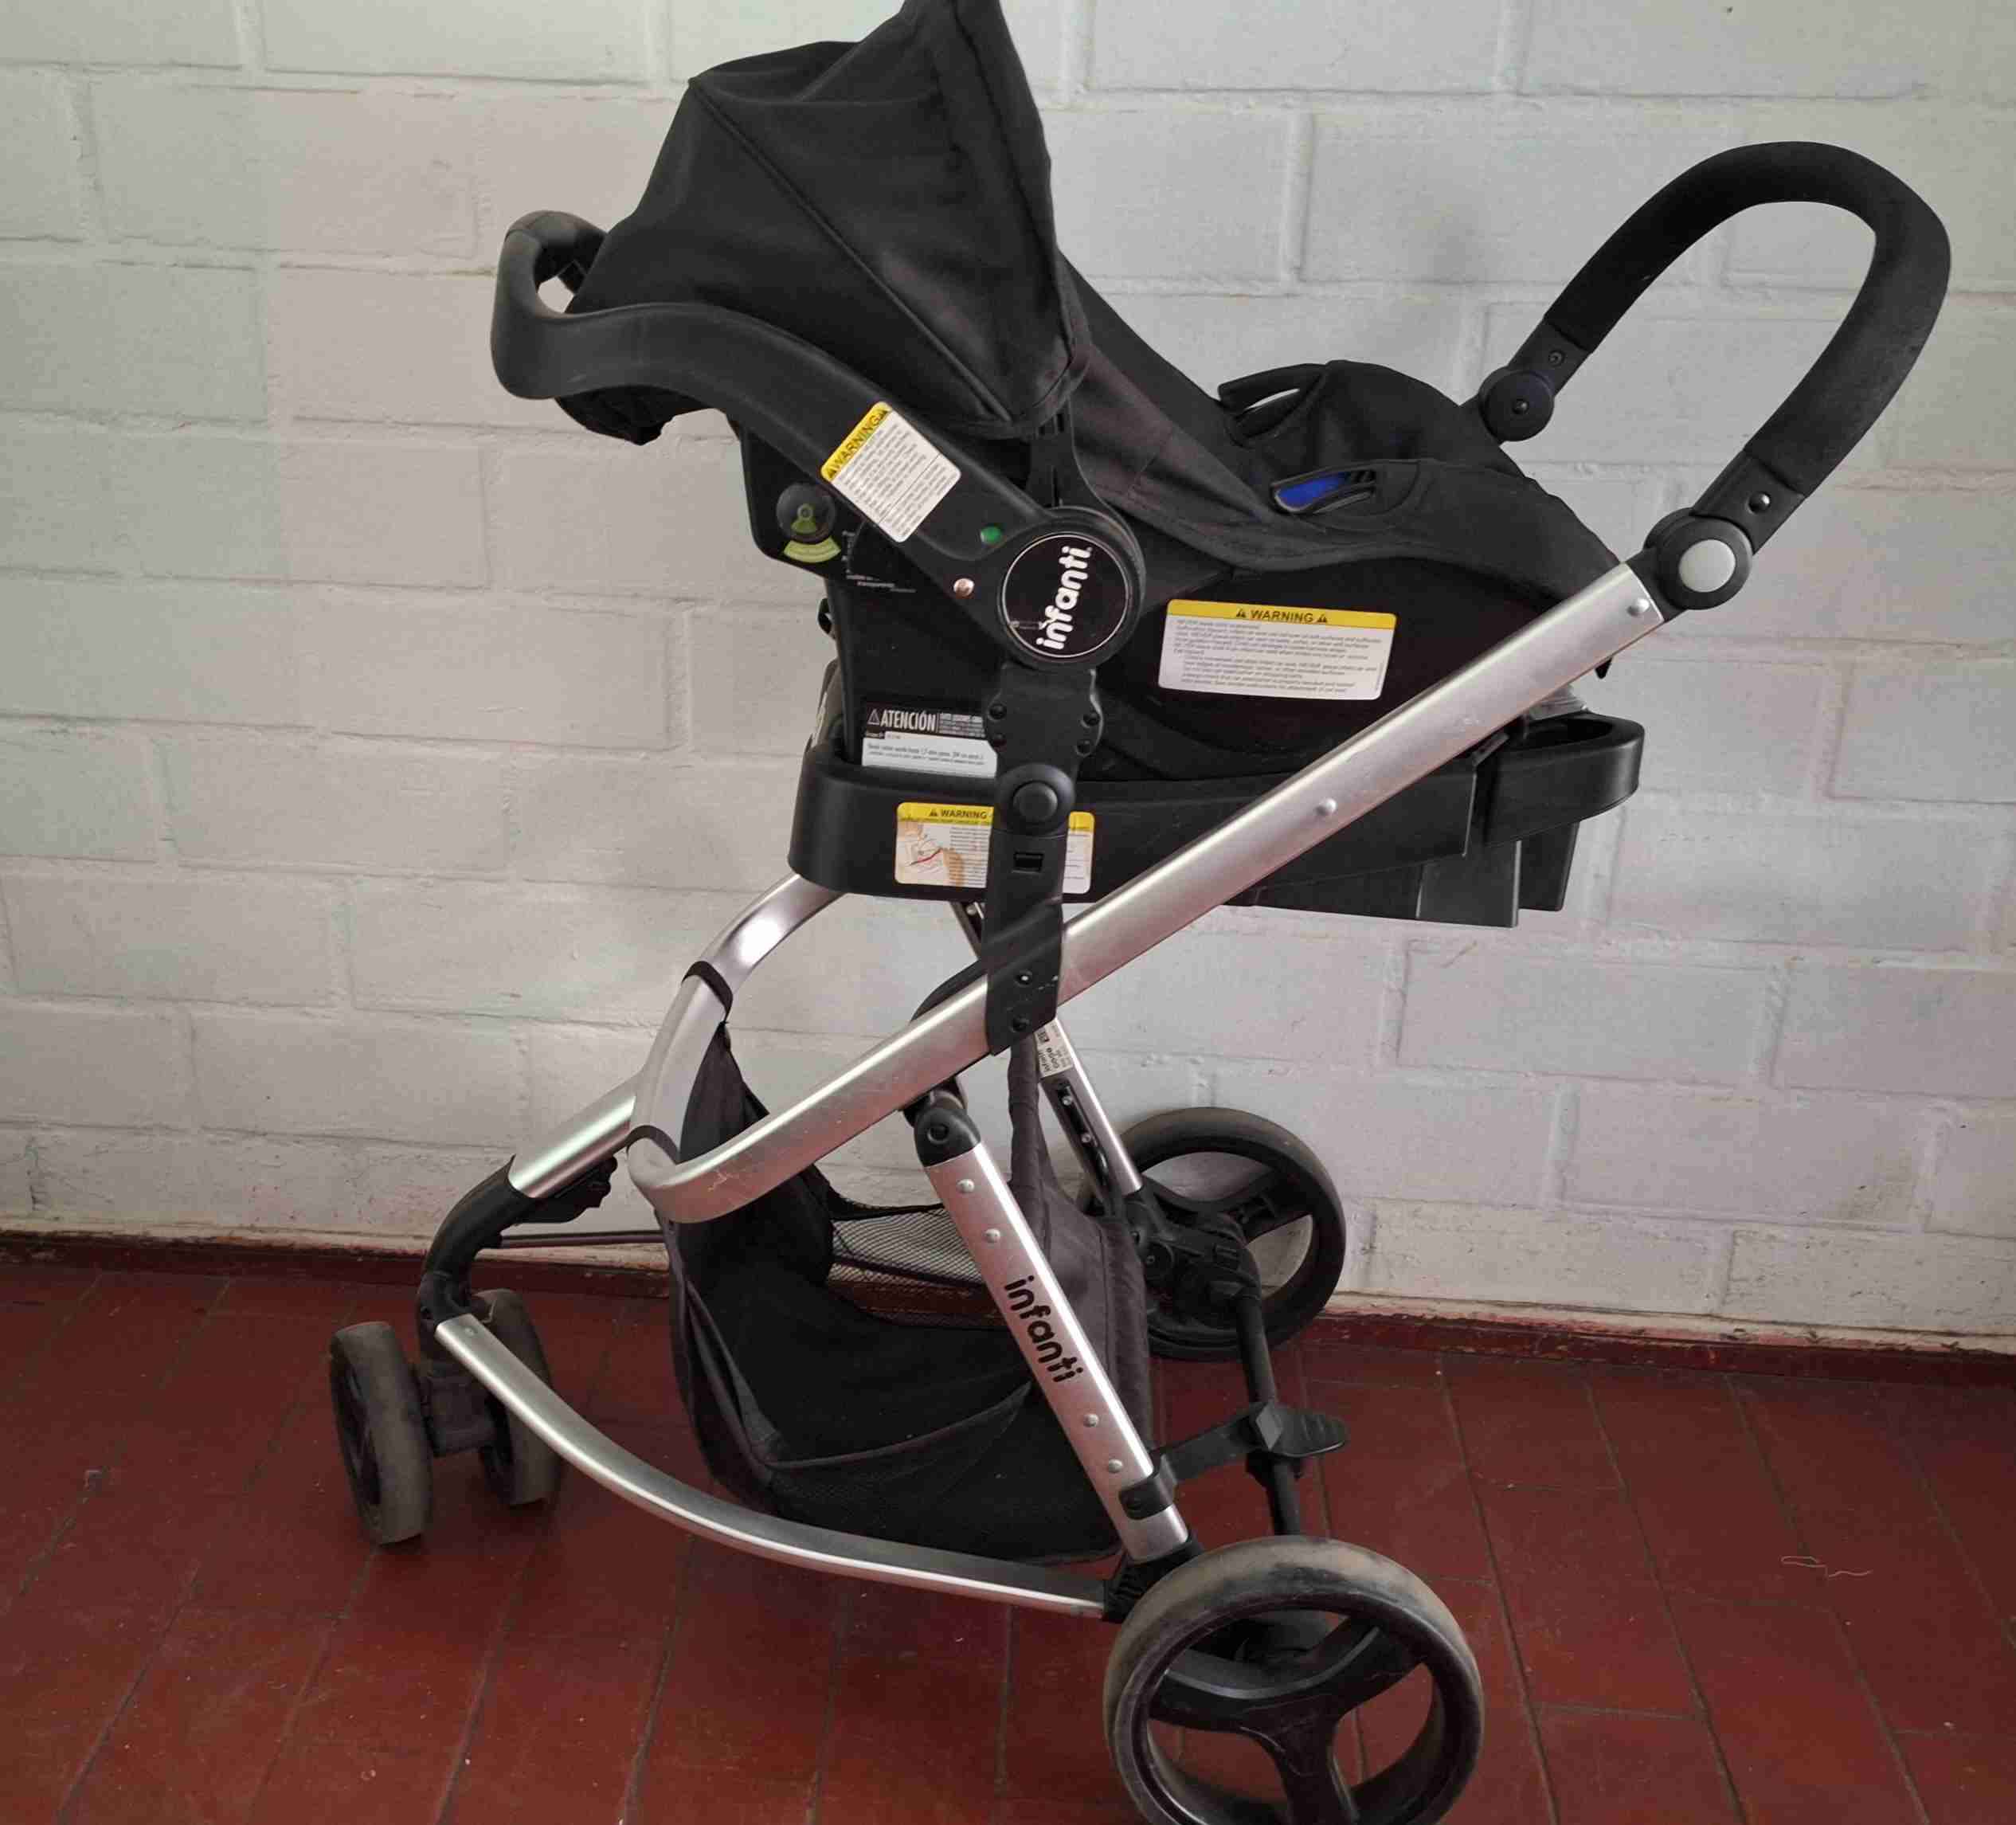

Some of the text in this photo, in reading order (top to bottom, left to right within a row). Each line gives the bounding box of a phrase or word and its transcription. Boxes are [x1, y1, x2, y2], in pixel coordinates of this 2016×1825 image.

[833, 413, 882, 469] WARNING
[1035, 545, 1091, 650] infanti
[1250, 609, 1314, 623] WARNING
[880, 709, 937, 731] ATENCIÓN
[940, 808, 988, 820] WARNING
[1004, 1275, 1084, 1383] infanti
